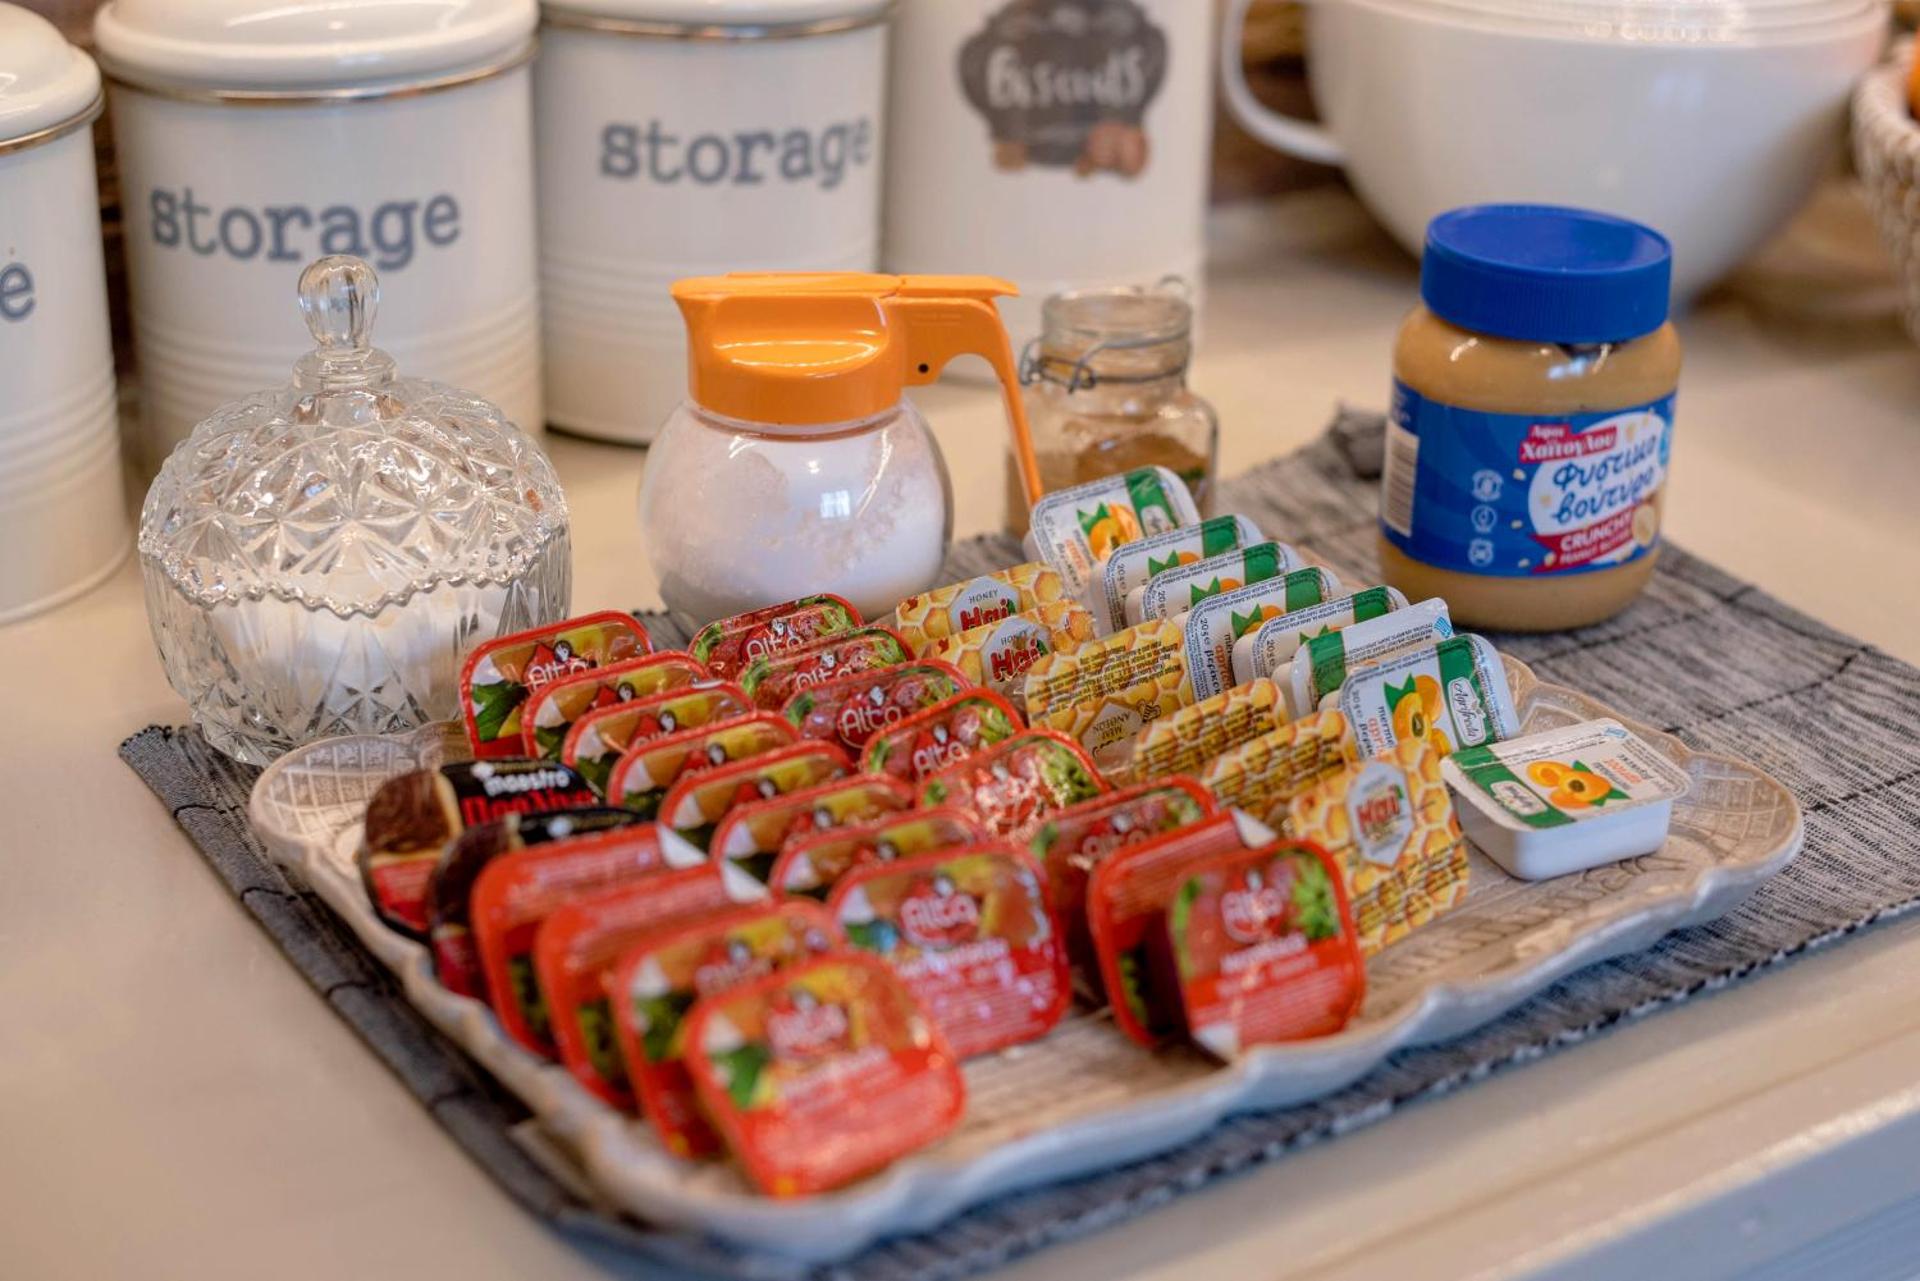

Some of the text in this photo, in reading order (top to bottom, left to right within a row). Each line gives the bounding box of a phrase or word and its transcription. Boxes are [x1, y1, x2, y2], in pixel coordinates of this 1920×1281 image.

[600, 117, 872, 189] storage
[150, 186, 460, 271] storage
[1560, 511, 1634, 550] CRUNCHY
[969, 589, 999, 604] HONEY
[1216, 645, 1231, 690] aprico
